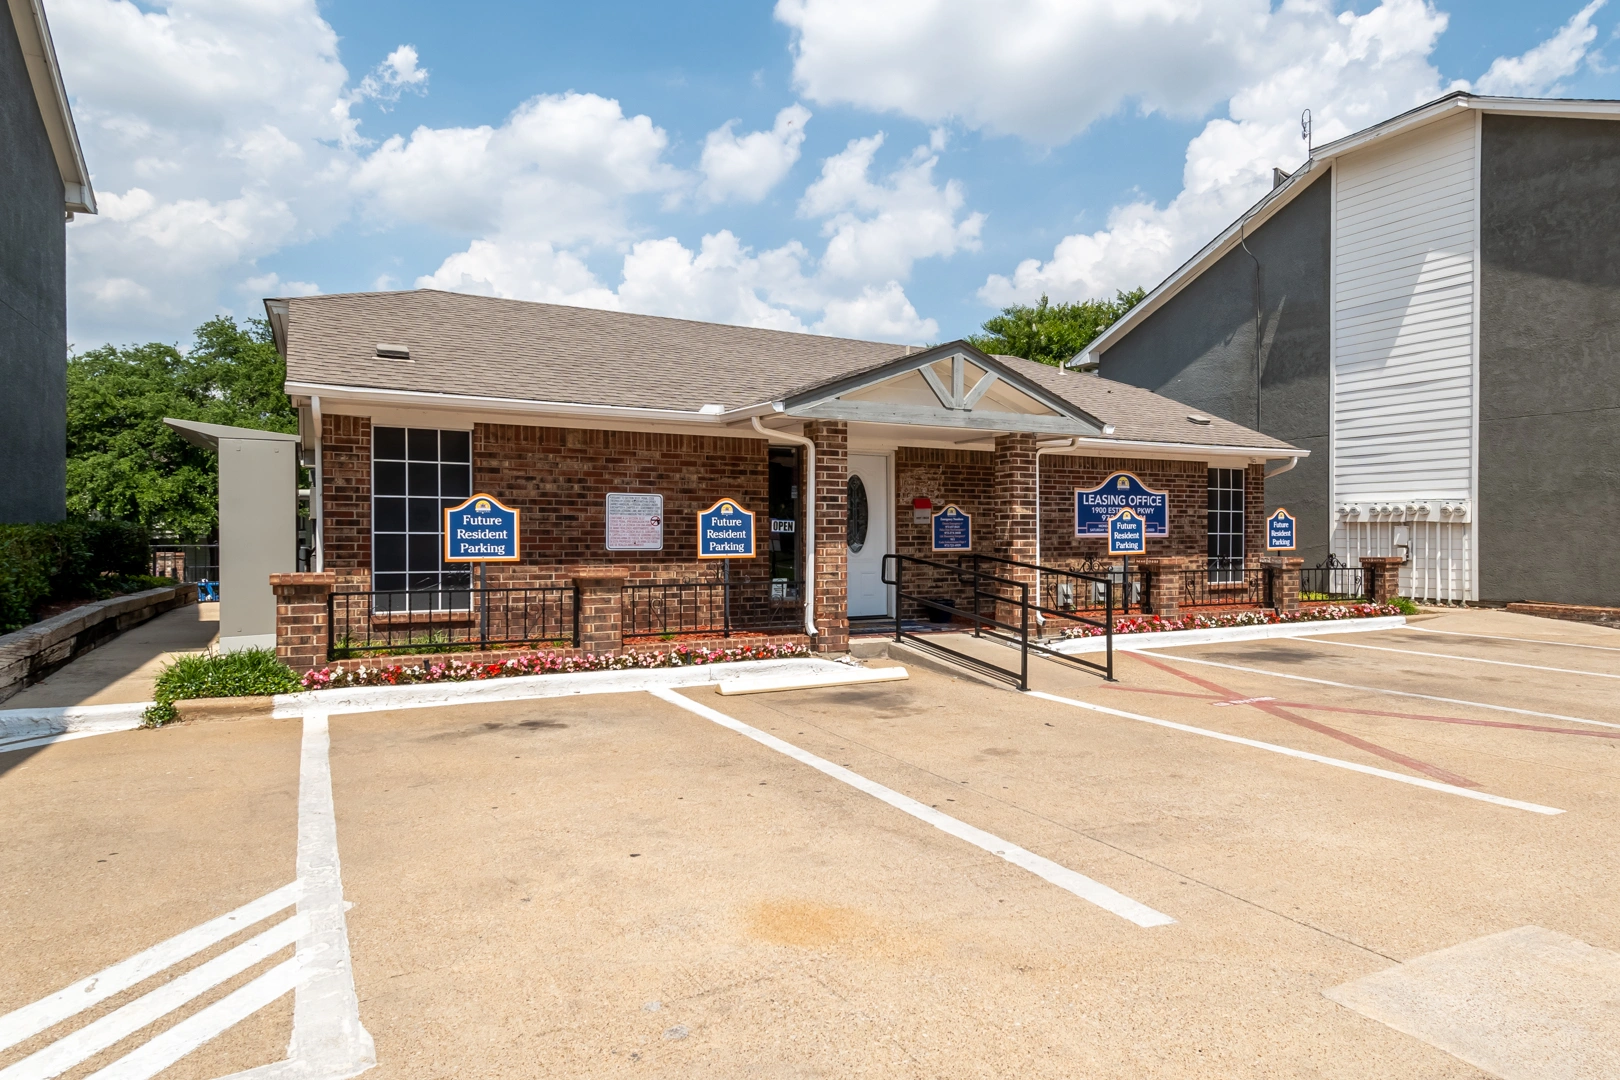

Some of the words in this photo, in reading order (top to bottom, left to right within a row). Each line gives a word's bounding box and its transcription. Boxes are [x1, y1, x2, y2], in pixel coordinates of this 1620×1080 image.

[1083, 494, 1126, 506] LEASING
[1128, 495, 1162, 506] OFFICE
[1091, 506, 1107, 514] 1900
[463, 514, 502, 525] Future
[711, 517, 742, 526] Future
[773, 521, 793, 531] OPEN
[457, 529, 508, 539] Resident
[707, 529, 746, 538] Resident
[709, 541, 744, 552] Parking
[1116, 541, 1138, 550] Parking
[1272, 538, 1290, 546] Parking
[460, 543, 505, 555] Parking
